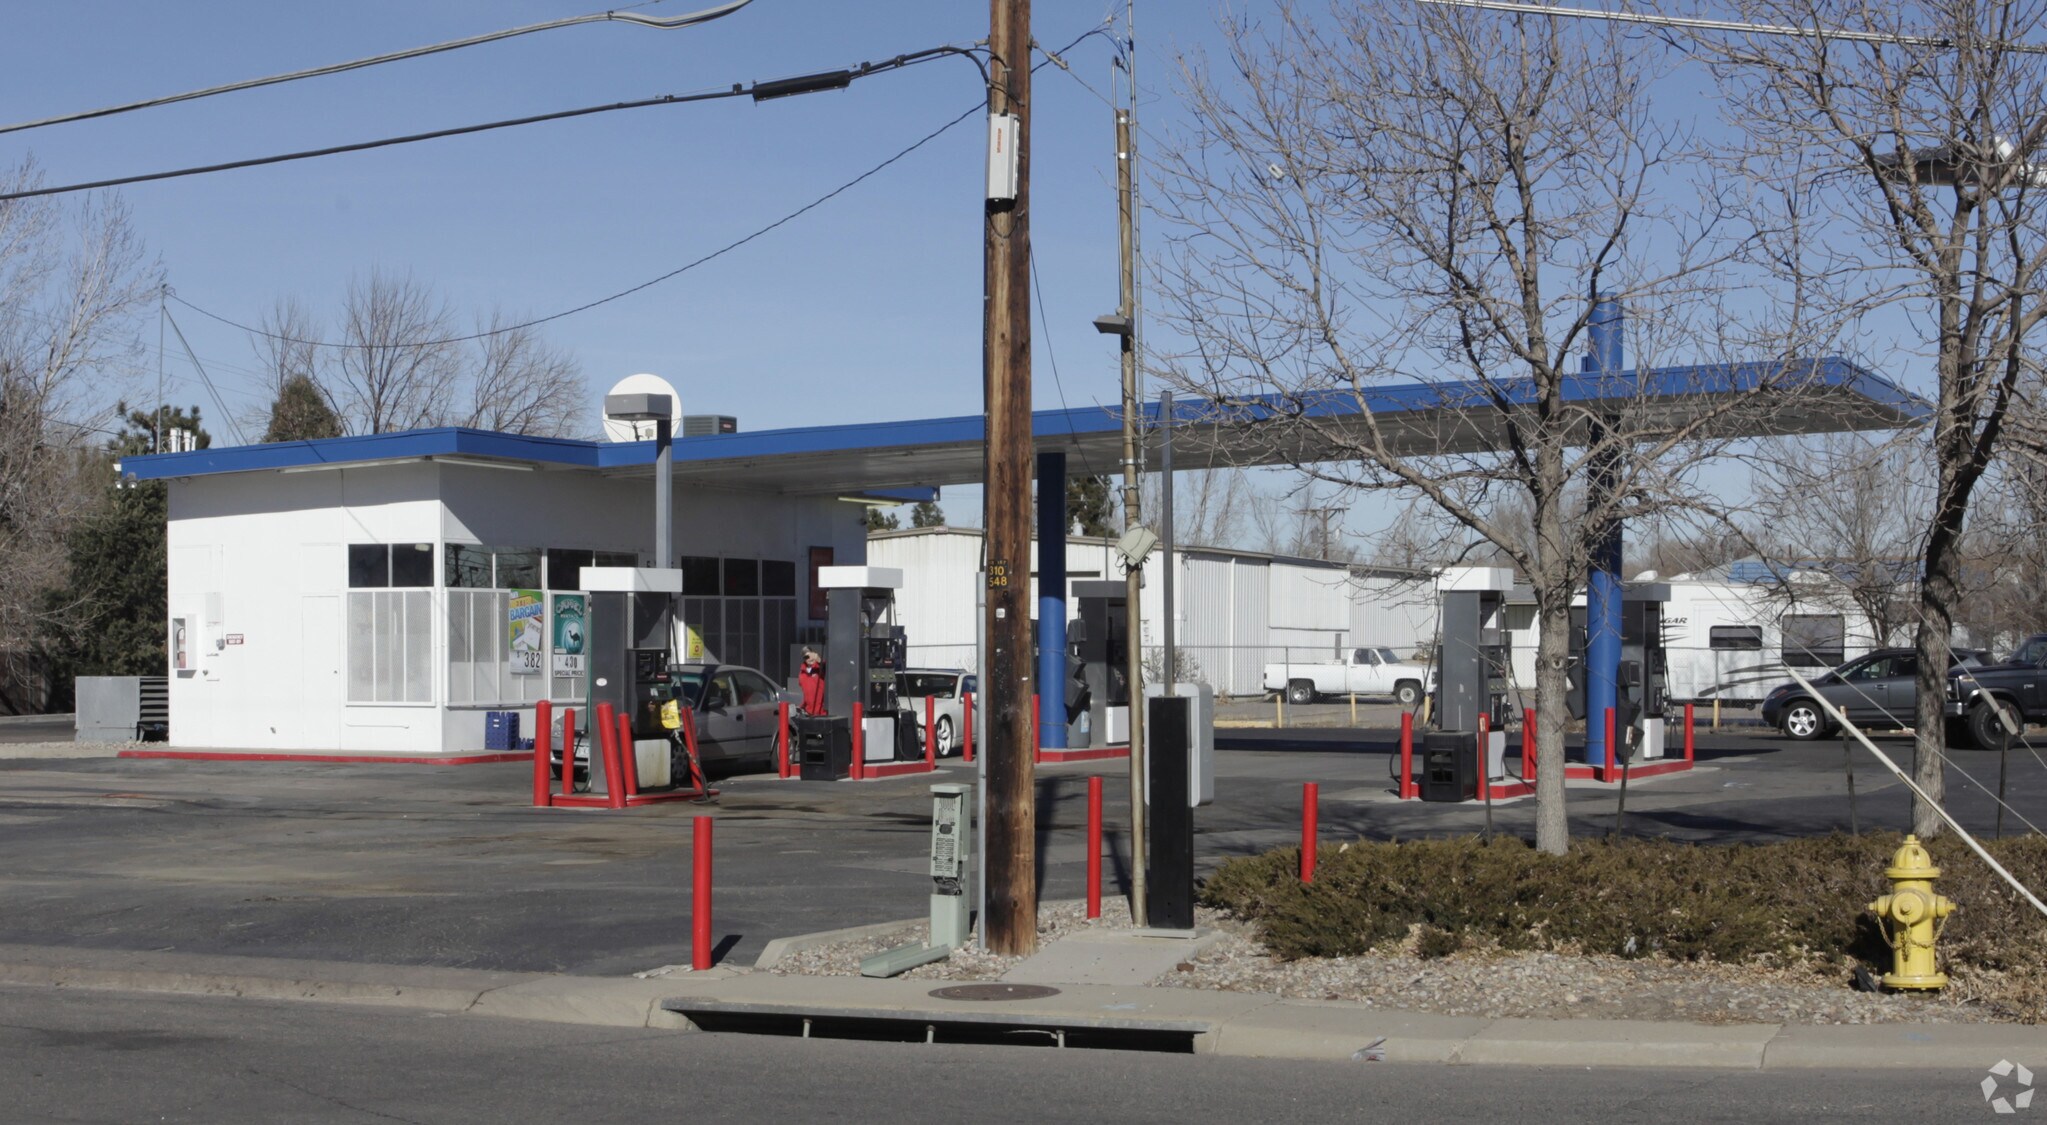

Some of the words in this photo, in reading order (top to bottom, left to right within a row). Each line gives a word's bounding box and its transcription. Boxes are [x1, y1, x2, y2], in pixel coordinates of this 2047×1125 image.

[989, 565, 1004, 576] 310
[989, 576, 1008, 587] 548
[510, 603, 543, 621] BARGAIN
[556, 599, 583, 616] CAMEL
[524, 651, 541, 668] 382
[565, 656, 578, 669] 430
